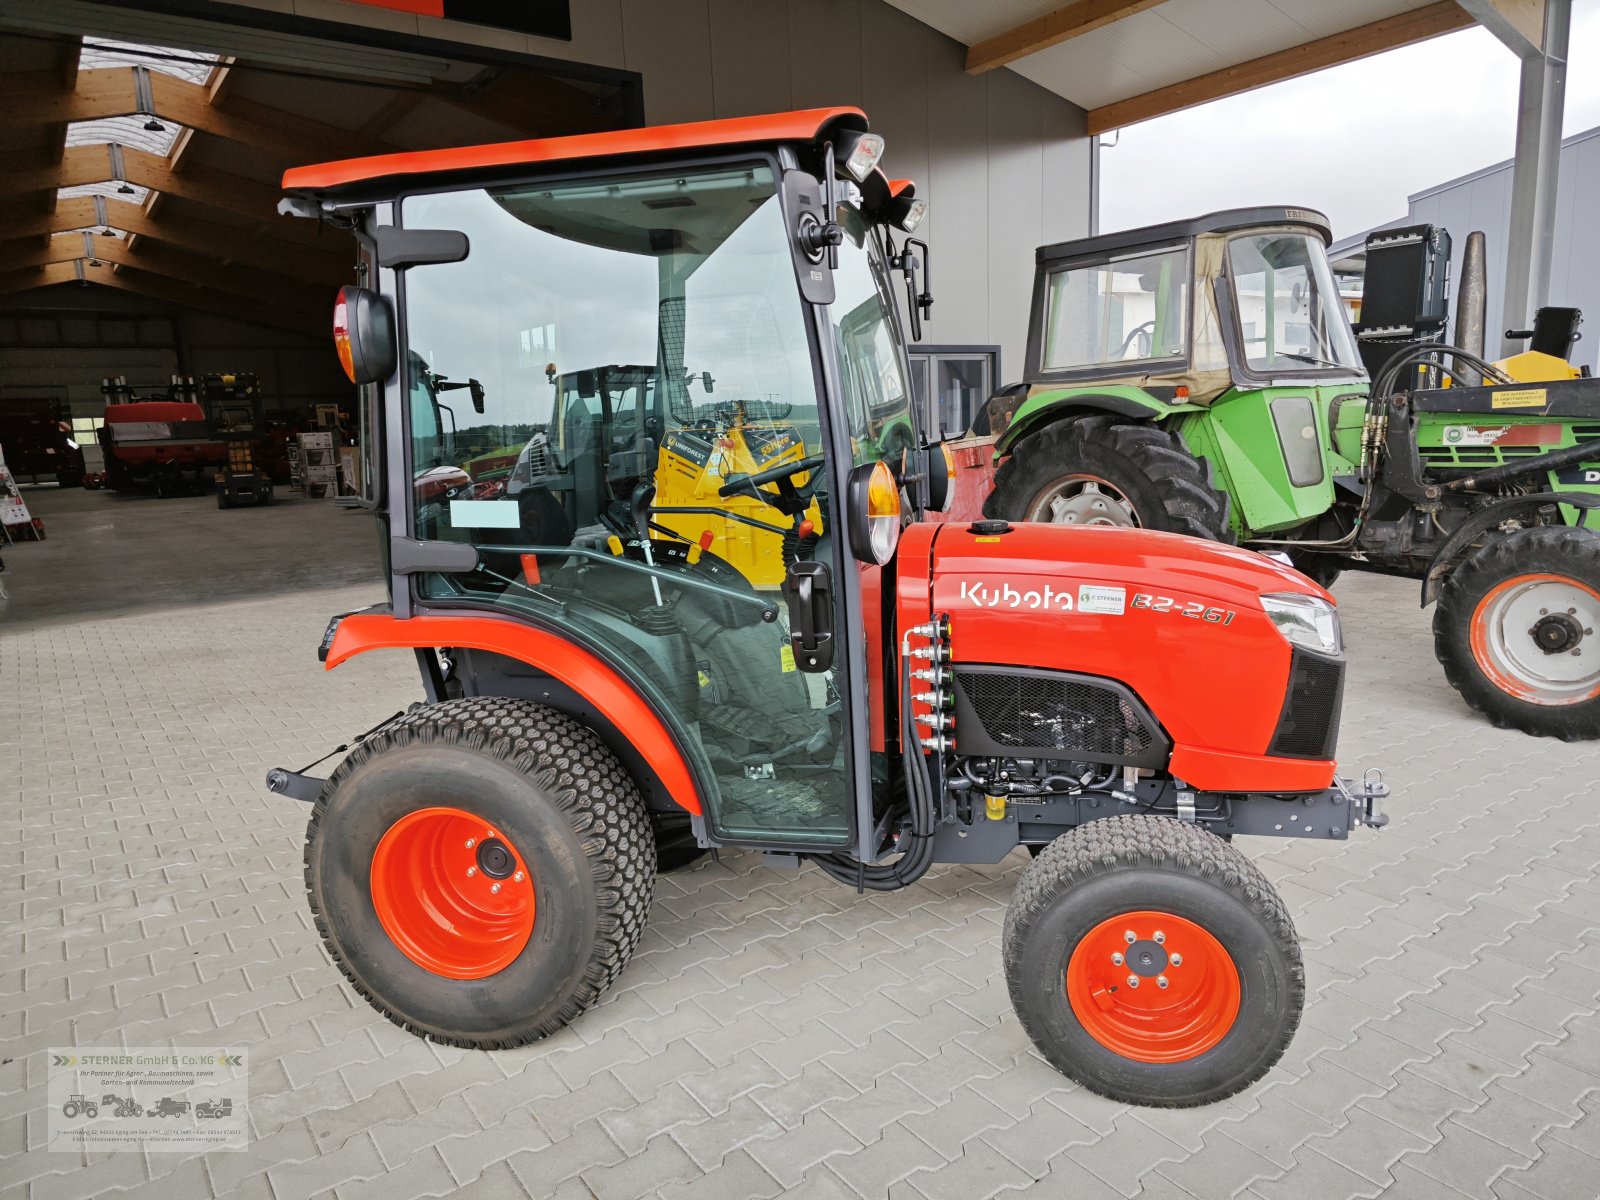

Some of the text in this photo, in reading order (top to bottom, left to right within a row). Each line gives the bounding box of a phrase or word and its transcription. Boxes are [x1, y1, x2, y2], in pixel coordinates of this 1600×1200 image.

[675, 441, 705, 460] UNIFOREST
[1585, 471, 1600, 482] D
[960, 581, 1073, 610] Kubota
[1131, 593, 1236, 625] B2-261
